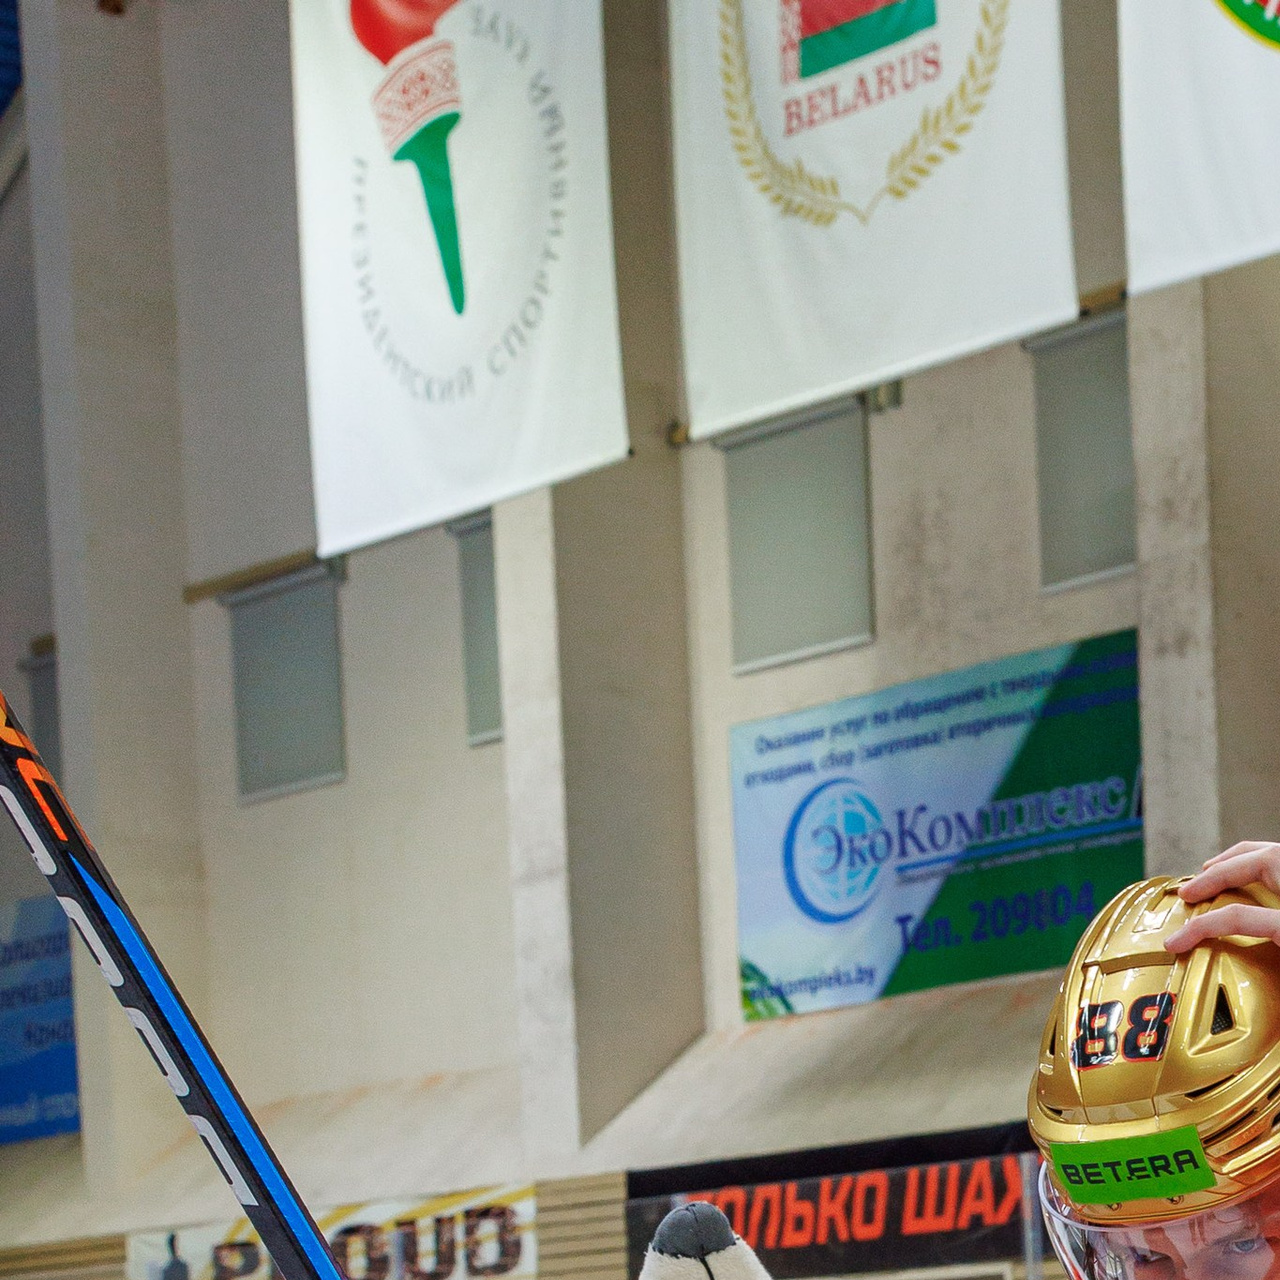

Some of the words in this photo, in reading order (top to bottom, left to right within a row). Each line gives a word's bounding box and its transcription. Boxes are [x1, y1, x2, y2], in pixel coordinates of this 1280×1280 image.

[784, 42, 942, 137] BELARUS
[895, 913, 963, 956] Тел.
[1070, 991, 1177, 1071] 88
[1061, 1148, 1201, 1186] BETERA
